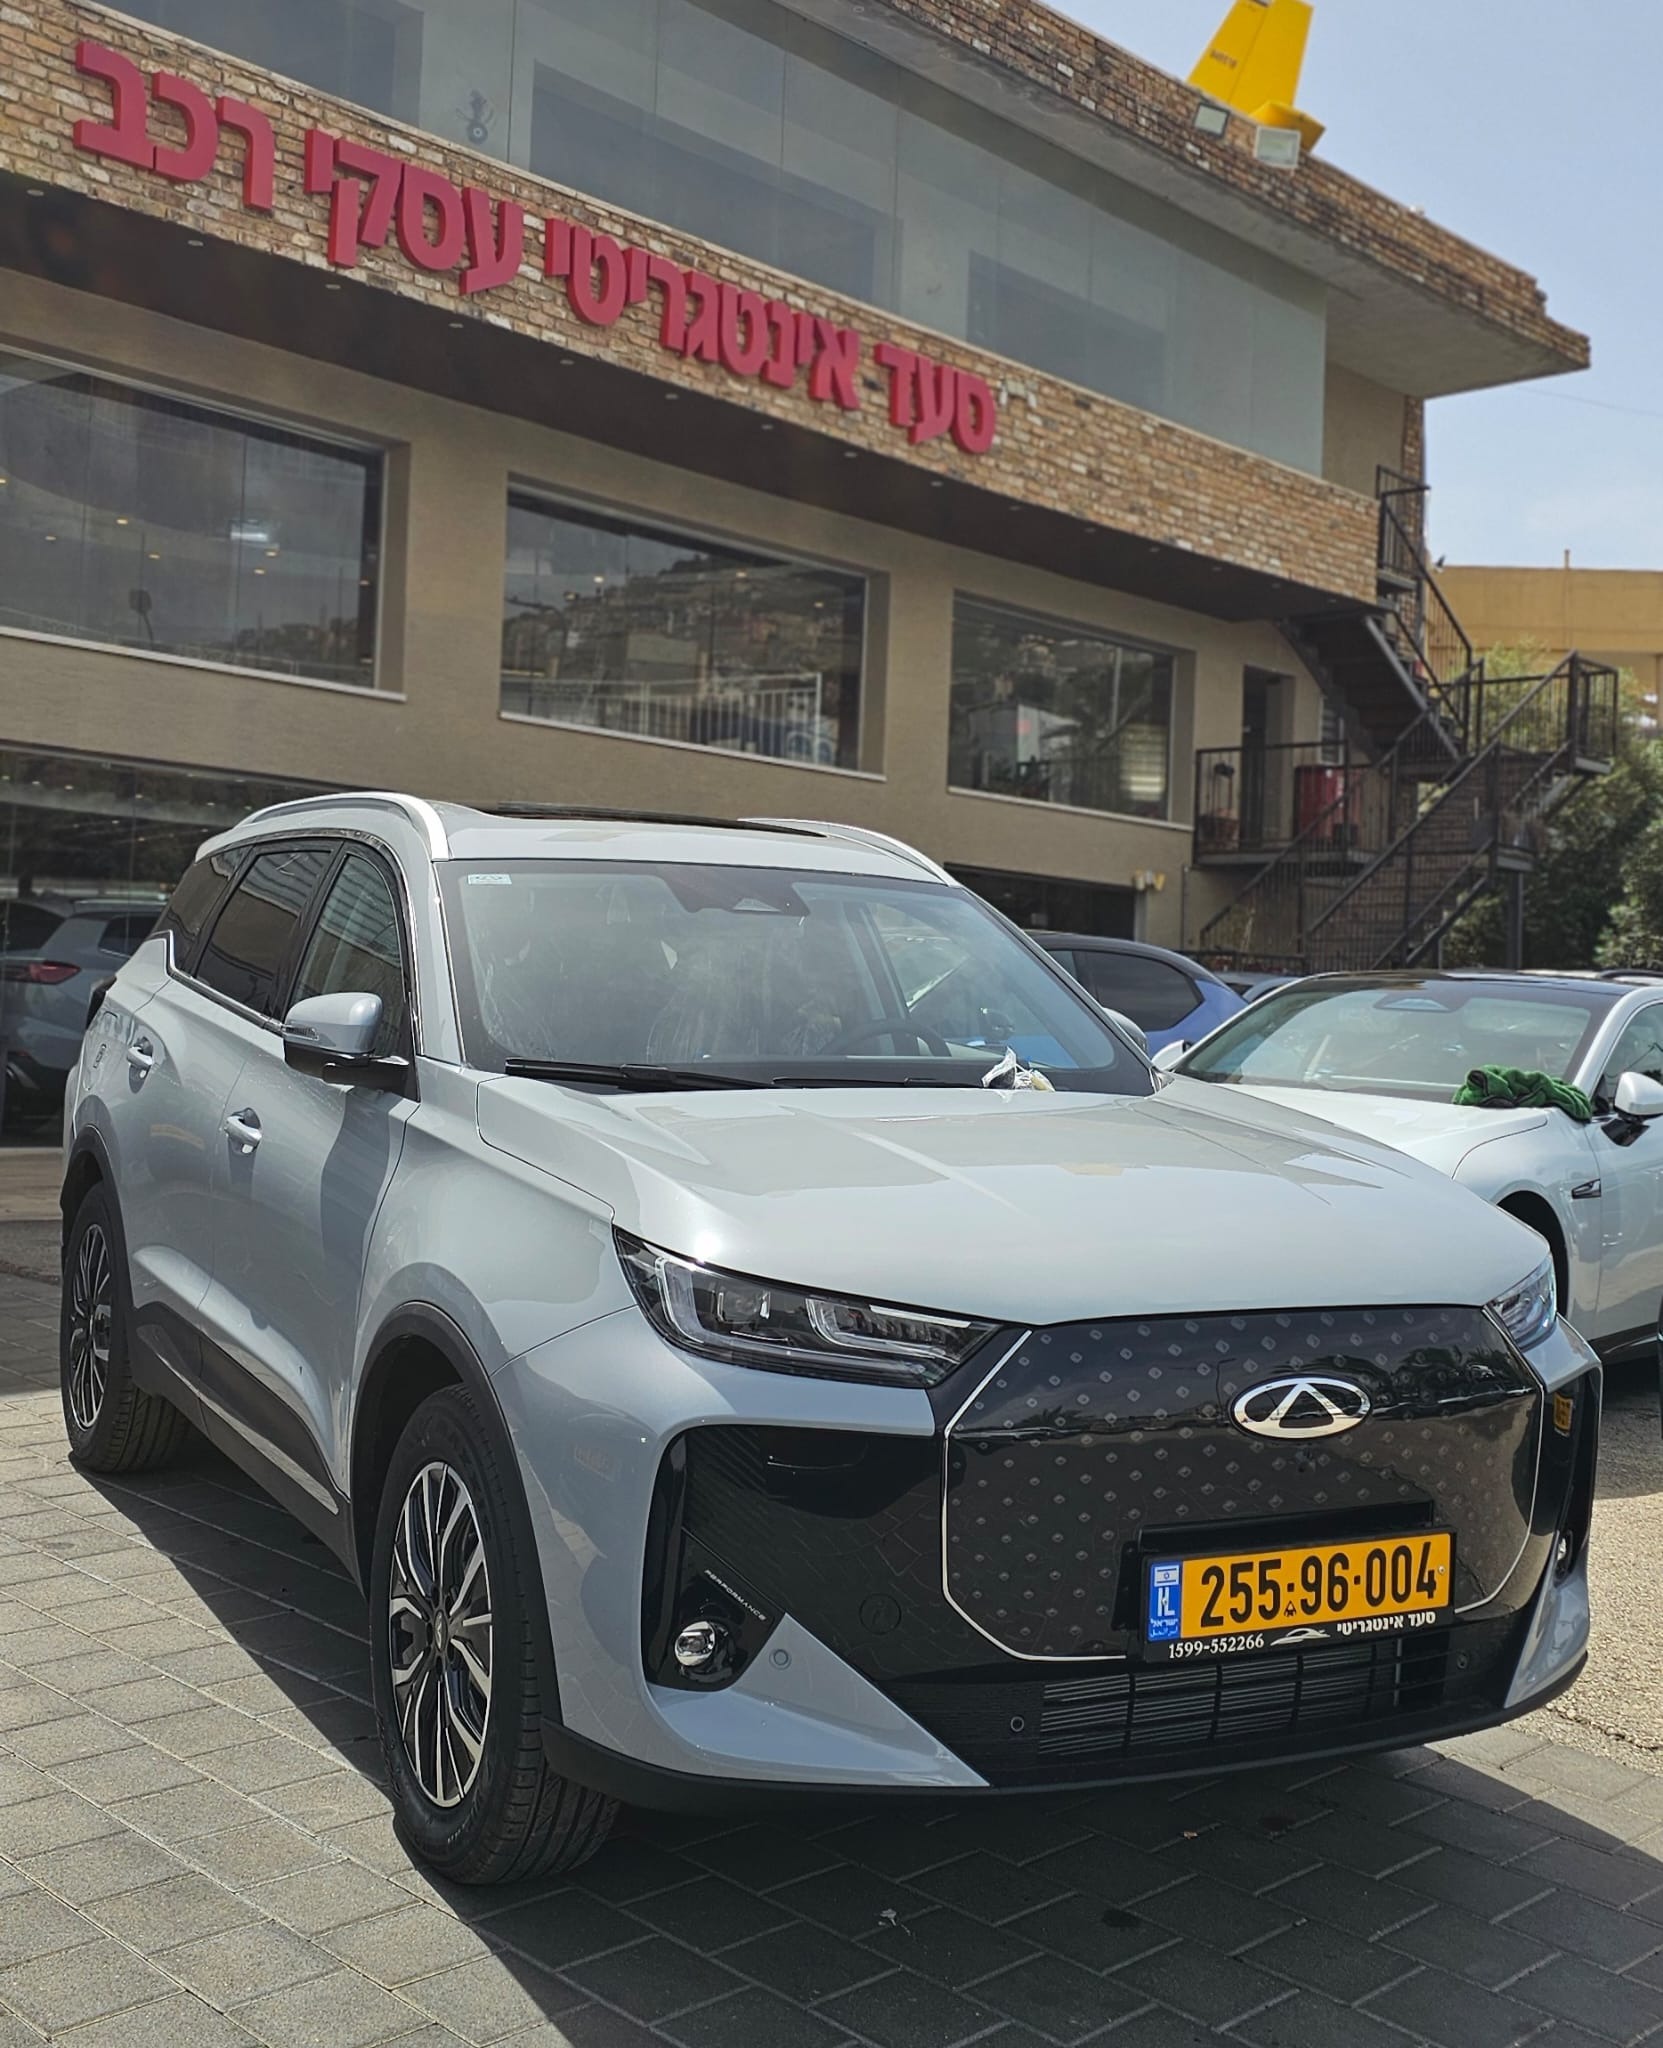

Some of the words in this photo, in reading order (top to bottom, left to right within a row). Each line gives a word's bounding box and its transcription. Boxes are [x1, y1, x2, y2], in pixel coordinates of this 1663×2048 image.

[73, 41, 274, 210] רכב
[304, 128, 524, 295] עסקי
[545, 217, 860, 410] אינטגריטי
[875, 342, 996, 454] סעד
[704, 1569, 767, 1620] PERFORMANCE
[1157, 1586, 1176, 1617] IL
[1408, 1611, 1436, 1627] סעד
[1168, 1633, 1265, 1659] 1599-552266
[1336, 1615, 1404, 1636] אינטגריטי
